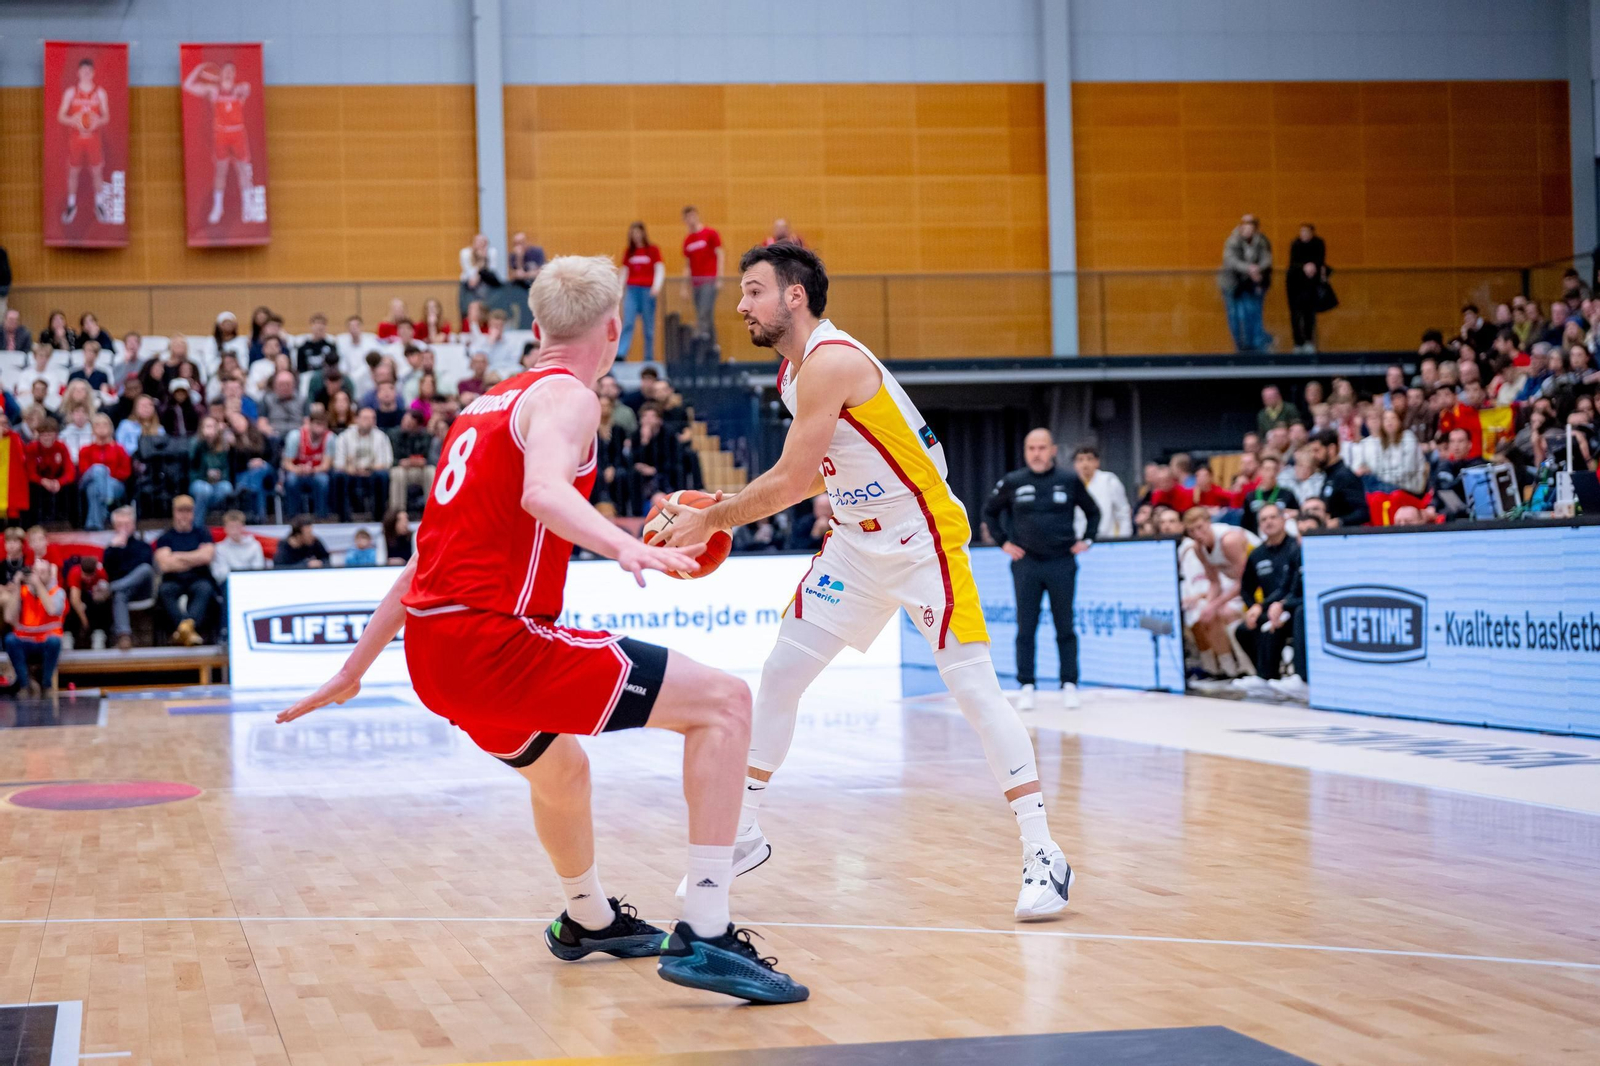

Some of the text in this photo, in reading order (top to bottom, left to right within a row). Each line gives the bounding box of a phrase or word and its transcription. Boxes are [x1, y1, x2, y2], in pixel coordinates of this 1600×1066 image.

[434, 426, 478, 506] 8
[270, 613, 372, 644] LIFET
[592, 604, 748, 632] samarbejde
[1329, 605, 1415, 645] LIFETIME
[1445, 609, 1522, 648] Kvalitets
